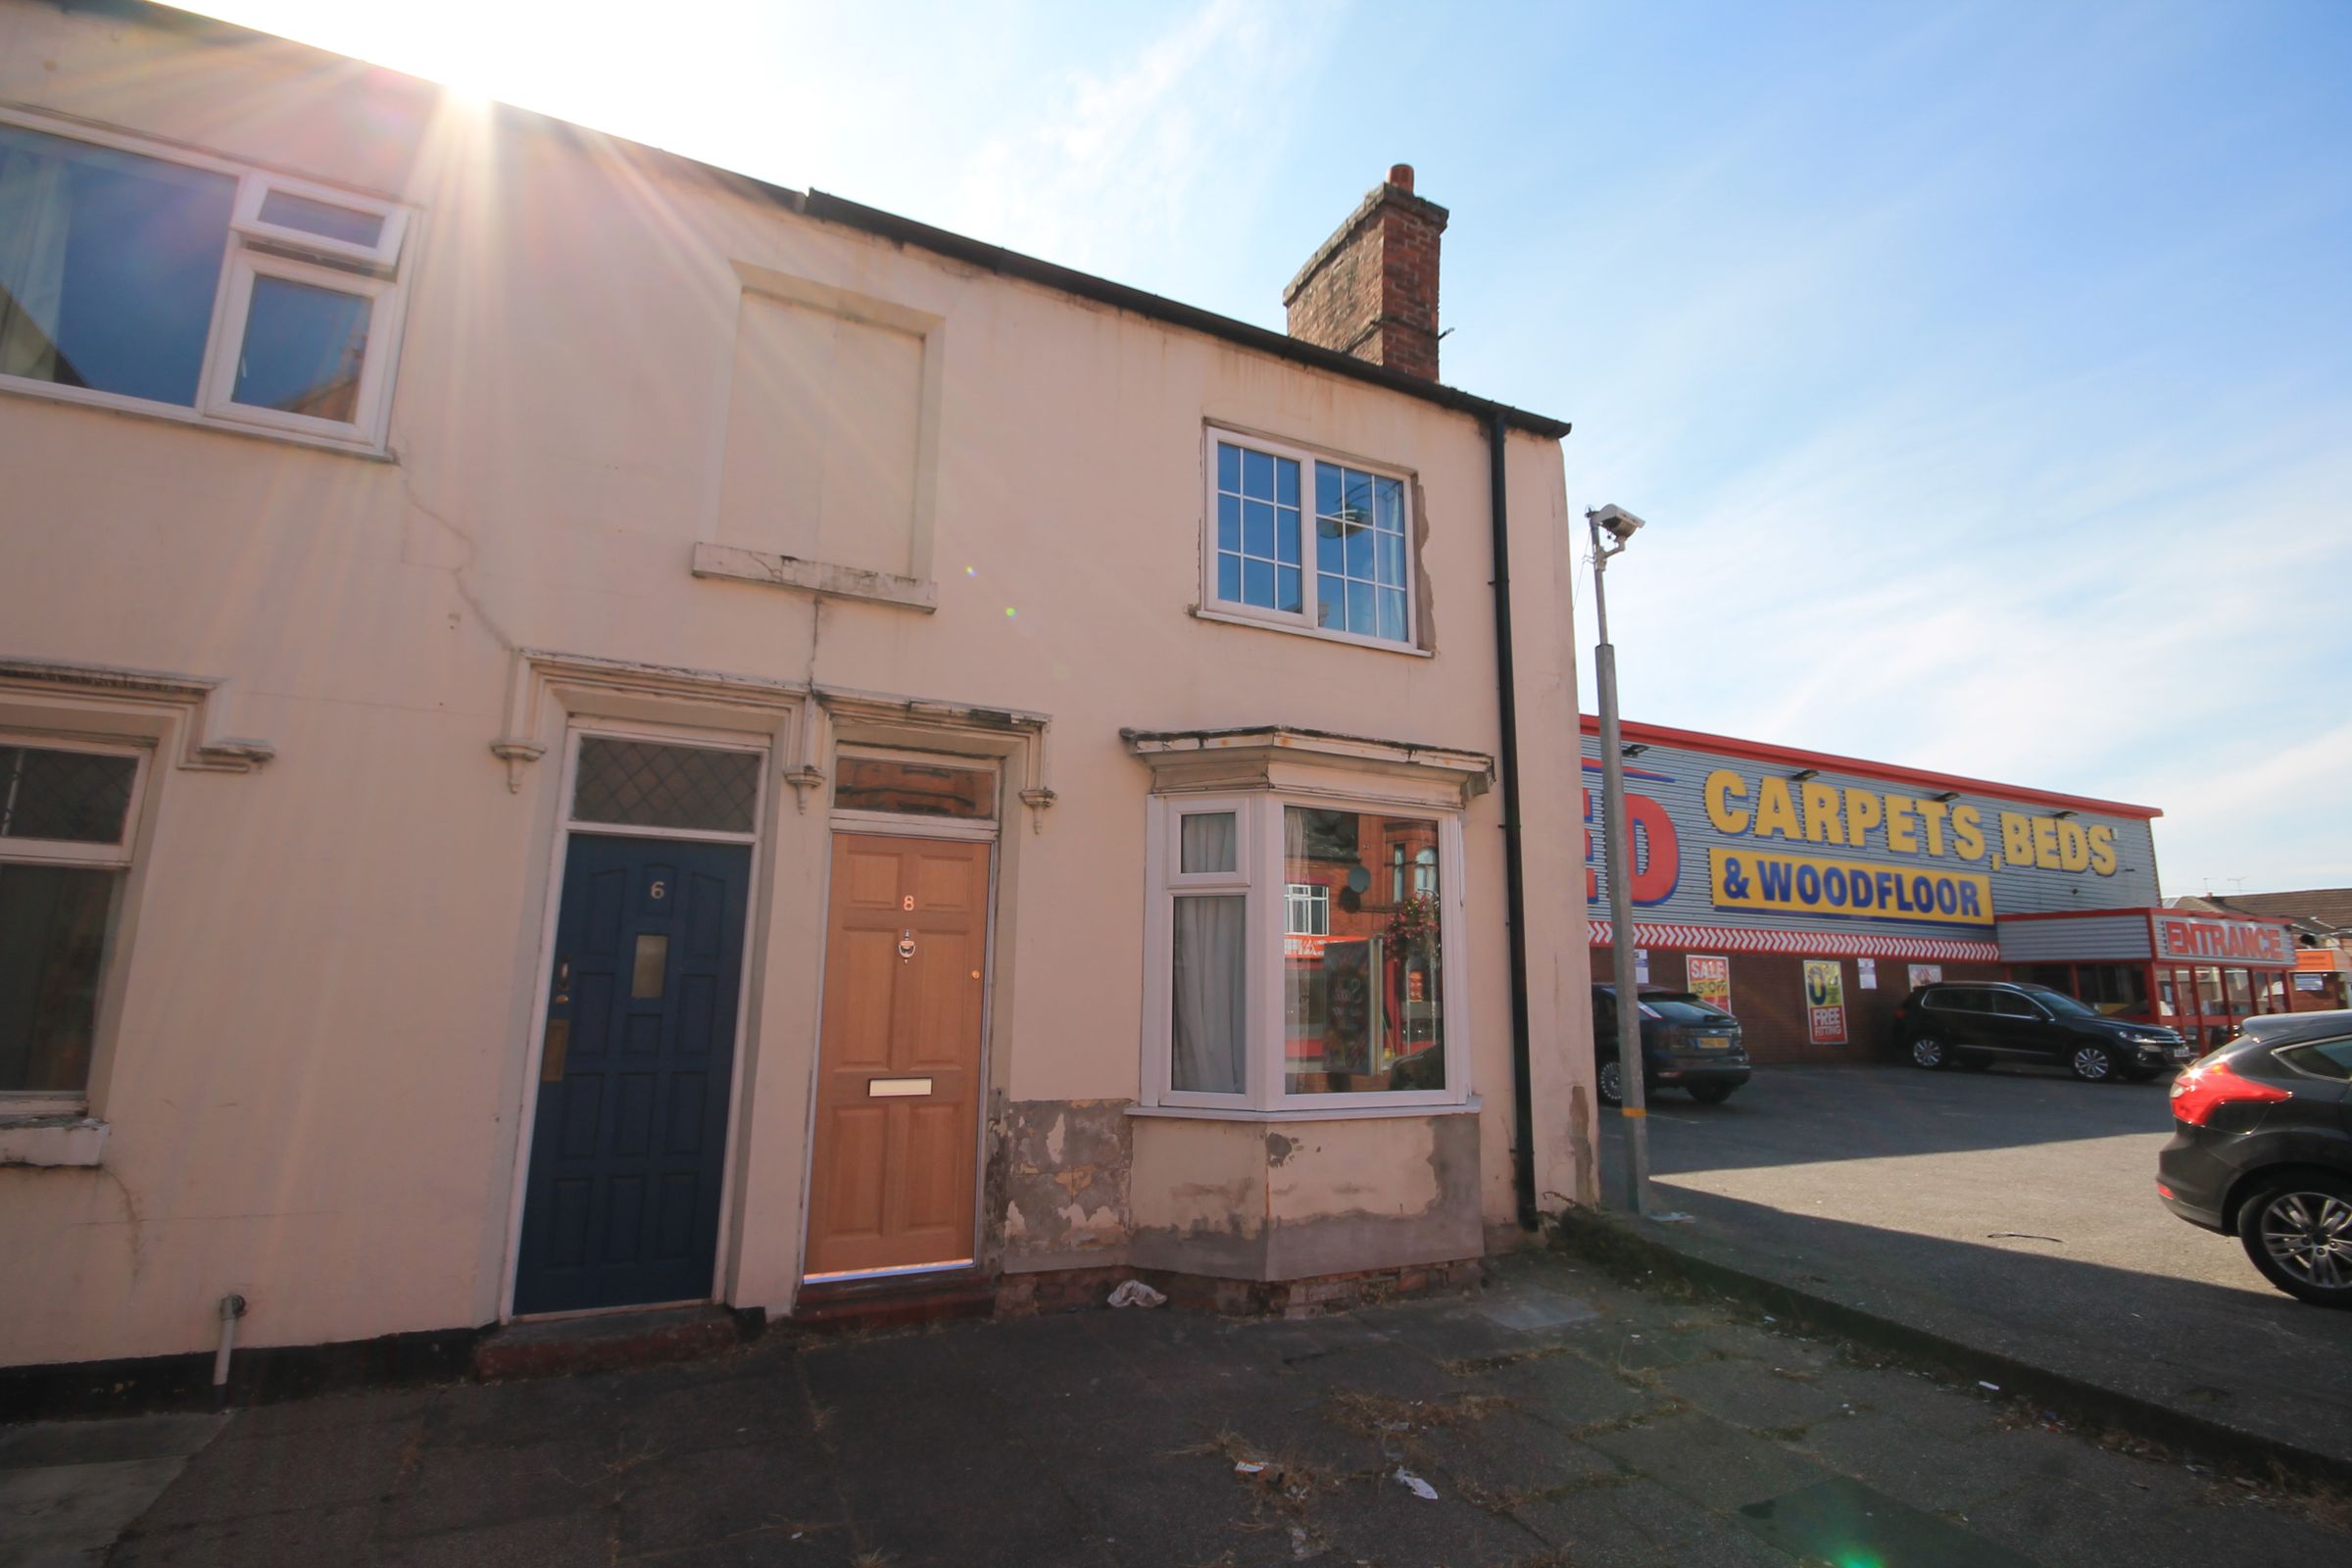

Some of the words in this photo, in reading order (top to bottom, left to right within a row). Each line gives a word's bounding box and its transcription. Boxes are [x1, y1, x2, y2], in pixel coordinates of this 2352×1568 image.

[1999, 810, 2118, 877] BEDS
[650, 881, 665, 900] 6
[1723, 857, 1750, 900] &
[1756, 859, 1981, 917] WOODFLOOR
[903, 895, 915, 911] 8
[2165, 920, 2285, 959] ENTRANCE
[1691, 959, 1726, 979] SALE
[1813, 1007, 1841, 1027] FREE
